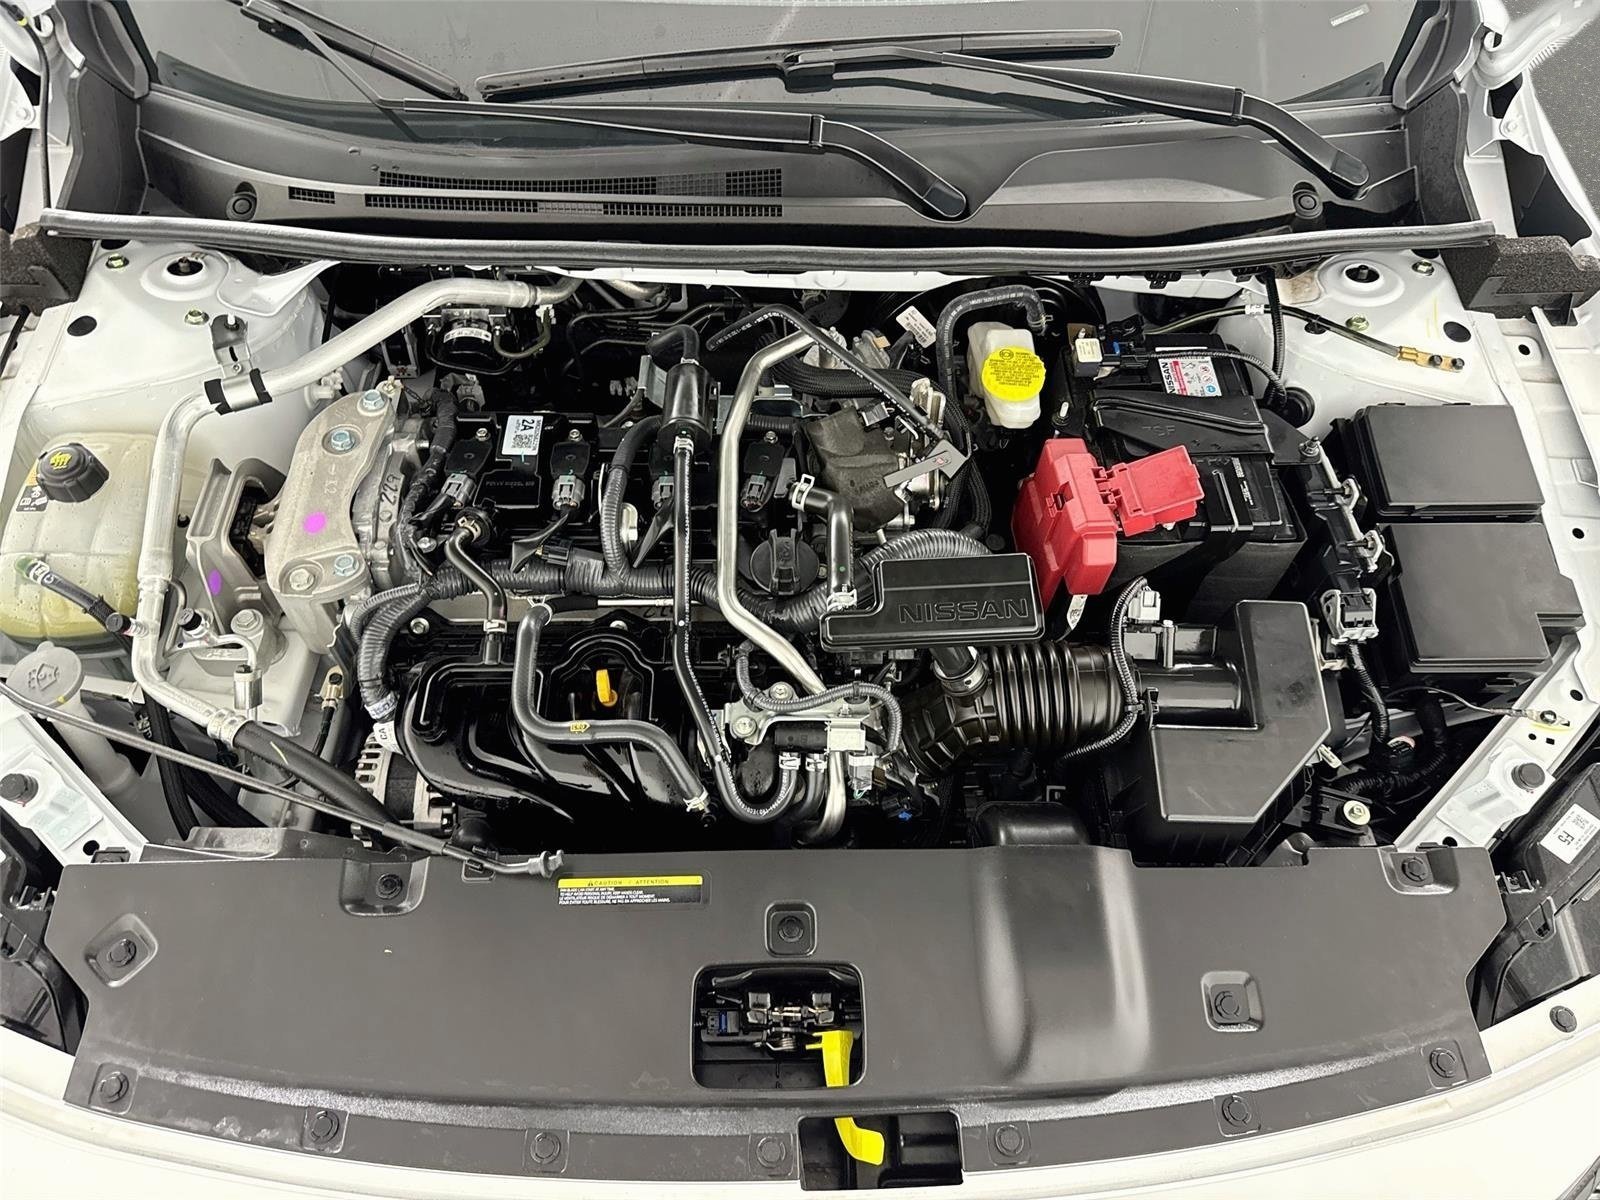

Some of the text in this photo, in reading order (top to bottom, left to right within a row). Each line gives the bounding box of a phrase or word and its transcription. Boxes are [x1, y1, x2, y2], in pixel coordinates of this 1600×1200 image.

[1161, 361, 1176, 394] NISSAN
[520, 419, 535, 431] 2A
[899, 598, 1029, 624] NISSAN
[1558, 830, 1575, 845] F5
